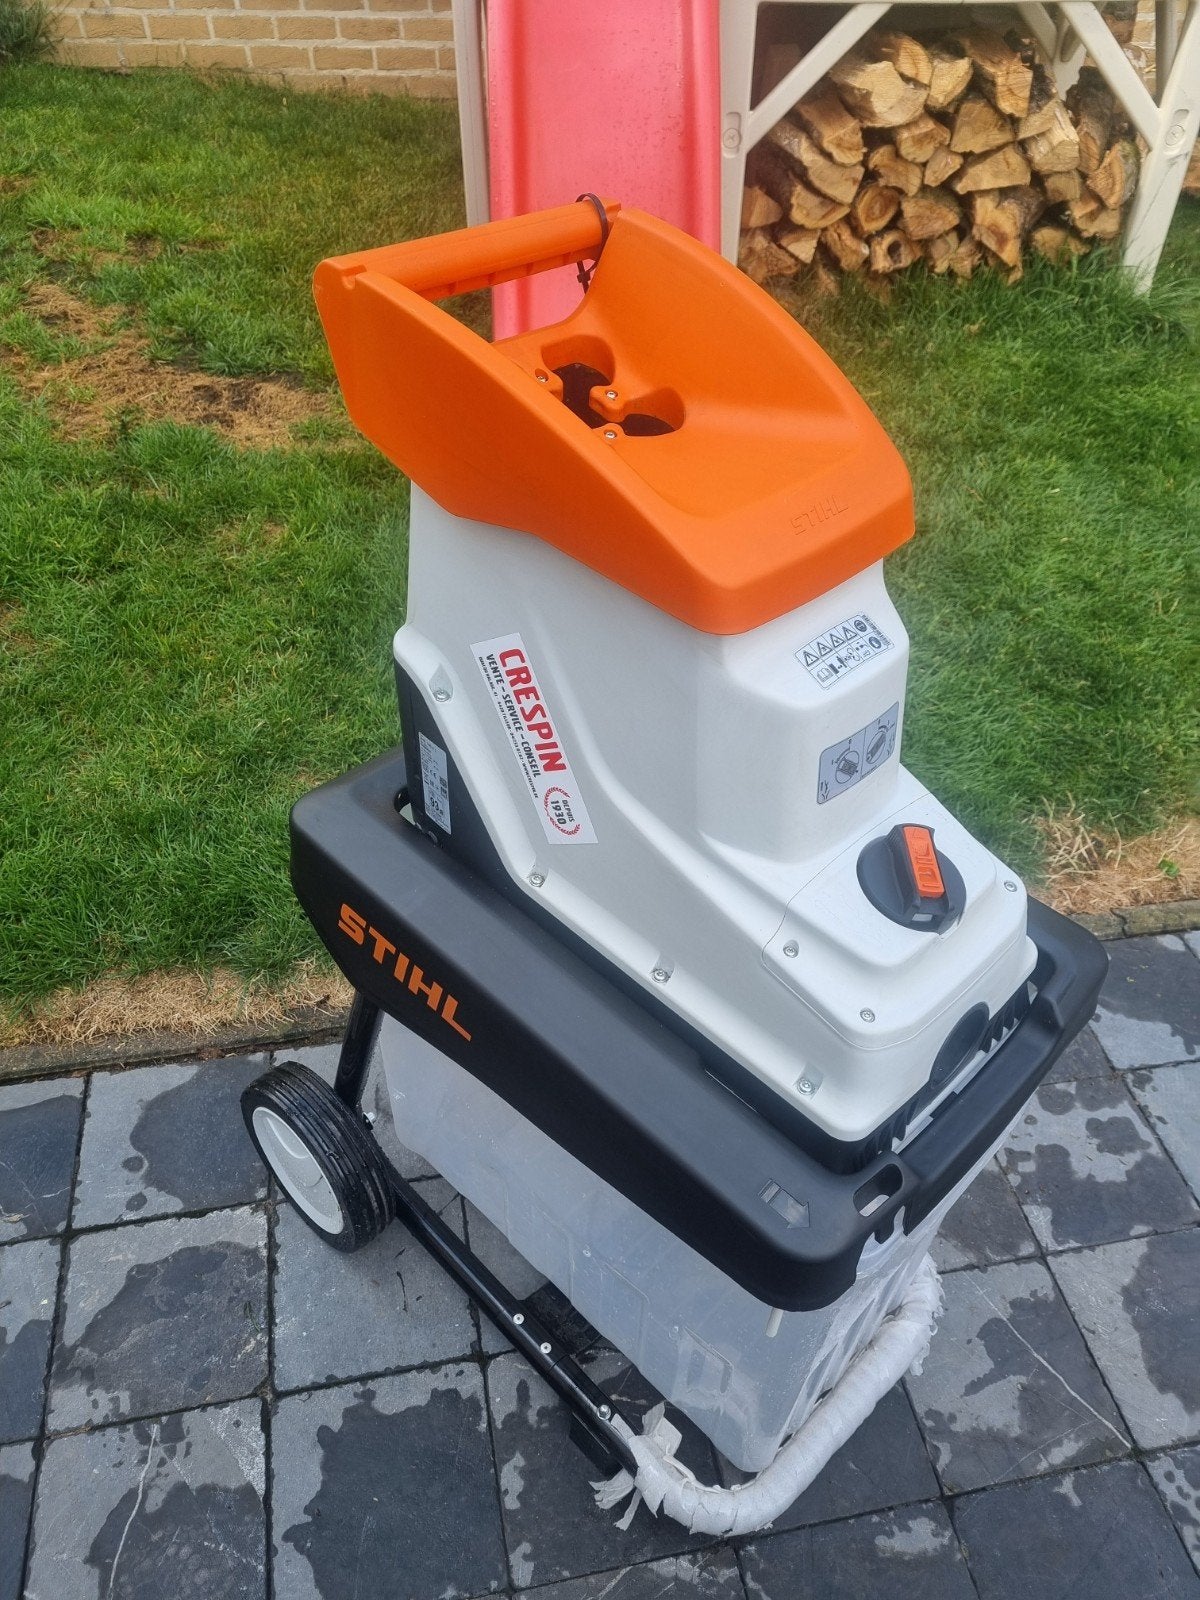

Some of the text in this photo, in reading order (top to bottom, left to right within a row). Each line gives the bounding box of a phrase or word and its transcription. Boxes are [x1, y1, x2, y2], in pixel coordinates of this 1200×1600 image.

[790, 494, 849, 536] STIHL
[486, 653, 504, 685] VENTE
[502, 693, 523, 732] SERVICE
[521, 740, 541, 778] CONSEIL
[498, 647, 567, 773] CRESPIN
[550, 799, 567, 825] 1930
[561, 799, 575, 822] DEPUIS
[338, 903, 472, 1042] STIHL
